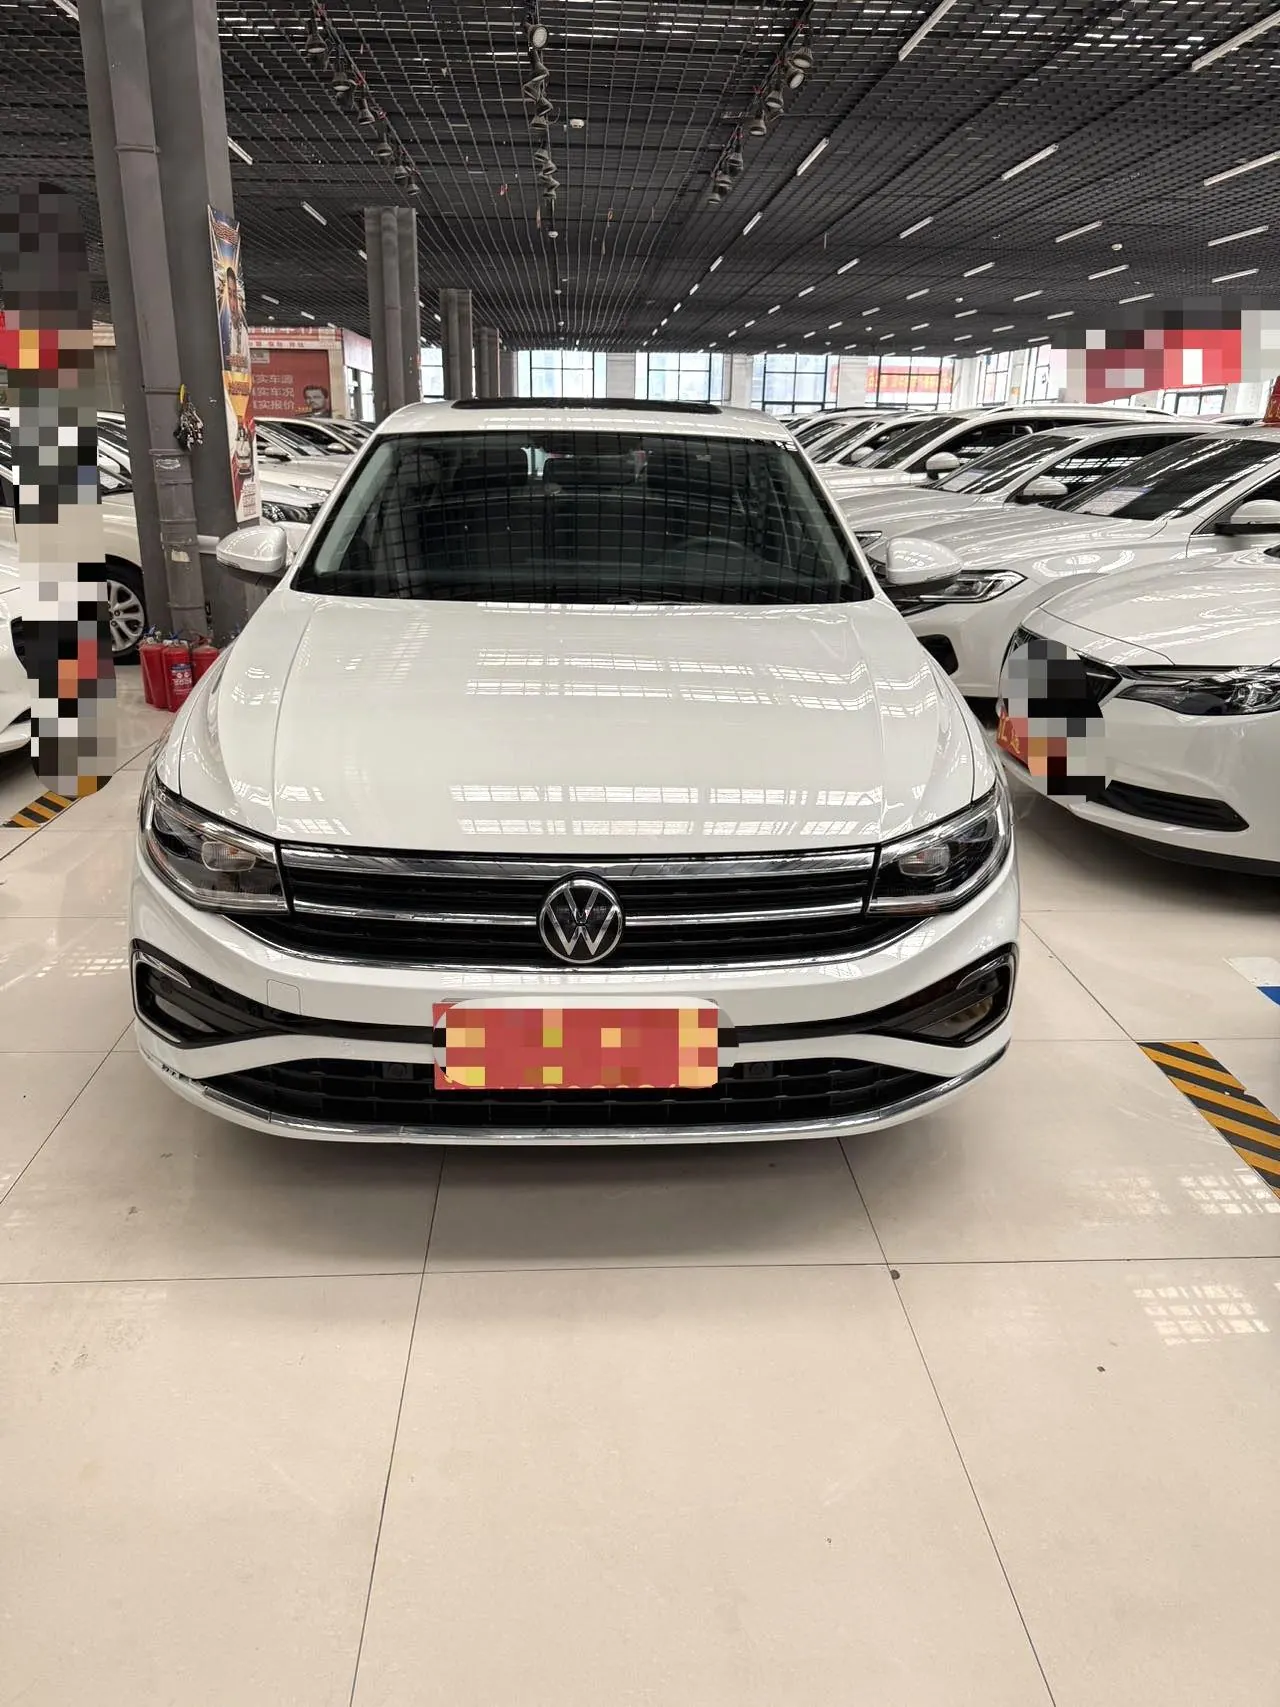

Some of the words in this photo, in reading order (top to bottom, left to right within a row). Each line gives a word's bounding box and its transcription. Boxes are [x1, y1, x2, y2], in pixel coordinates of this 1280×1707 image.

[253, 374, 294, 385] 实车源
[253, 387, 295, 397] 实车况
